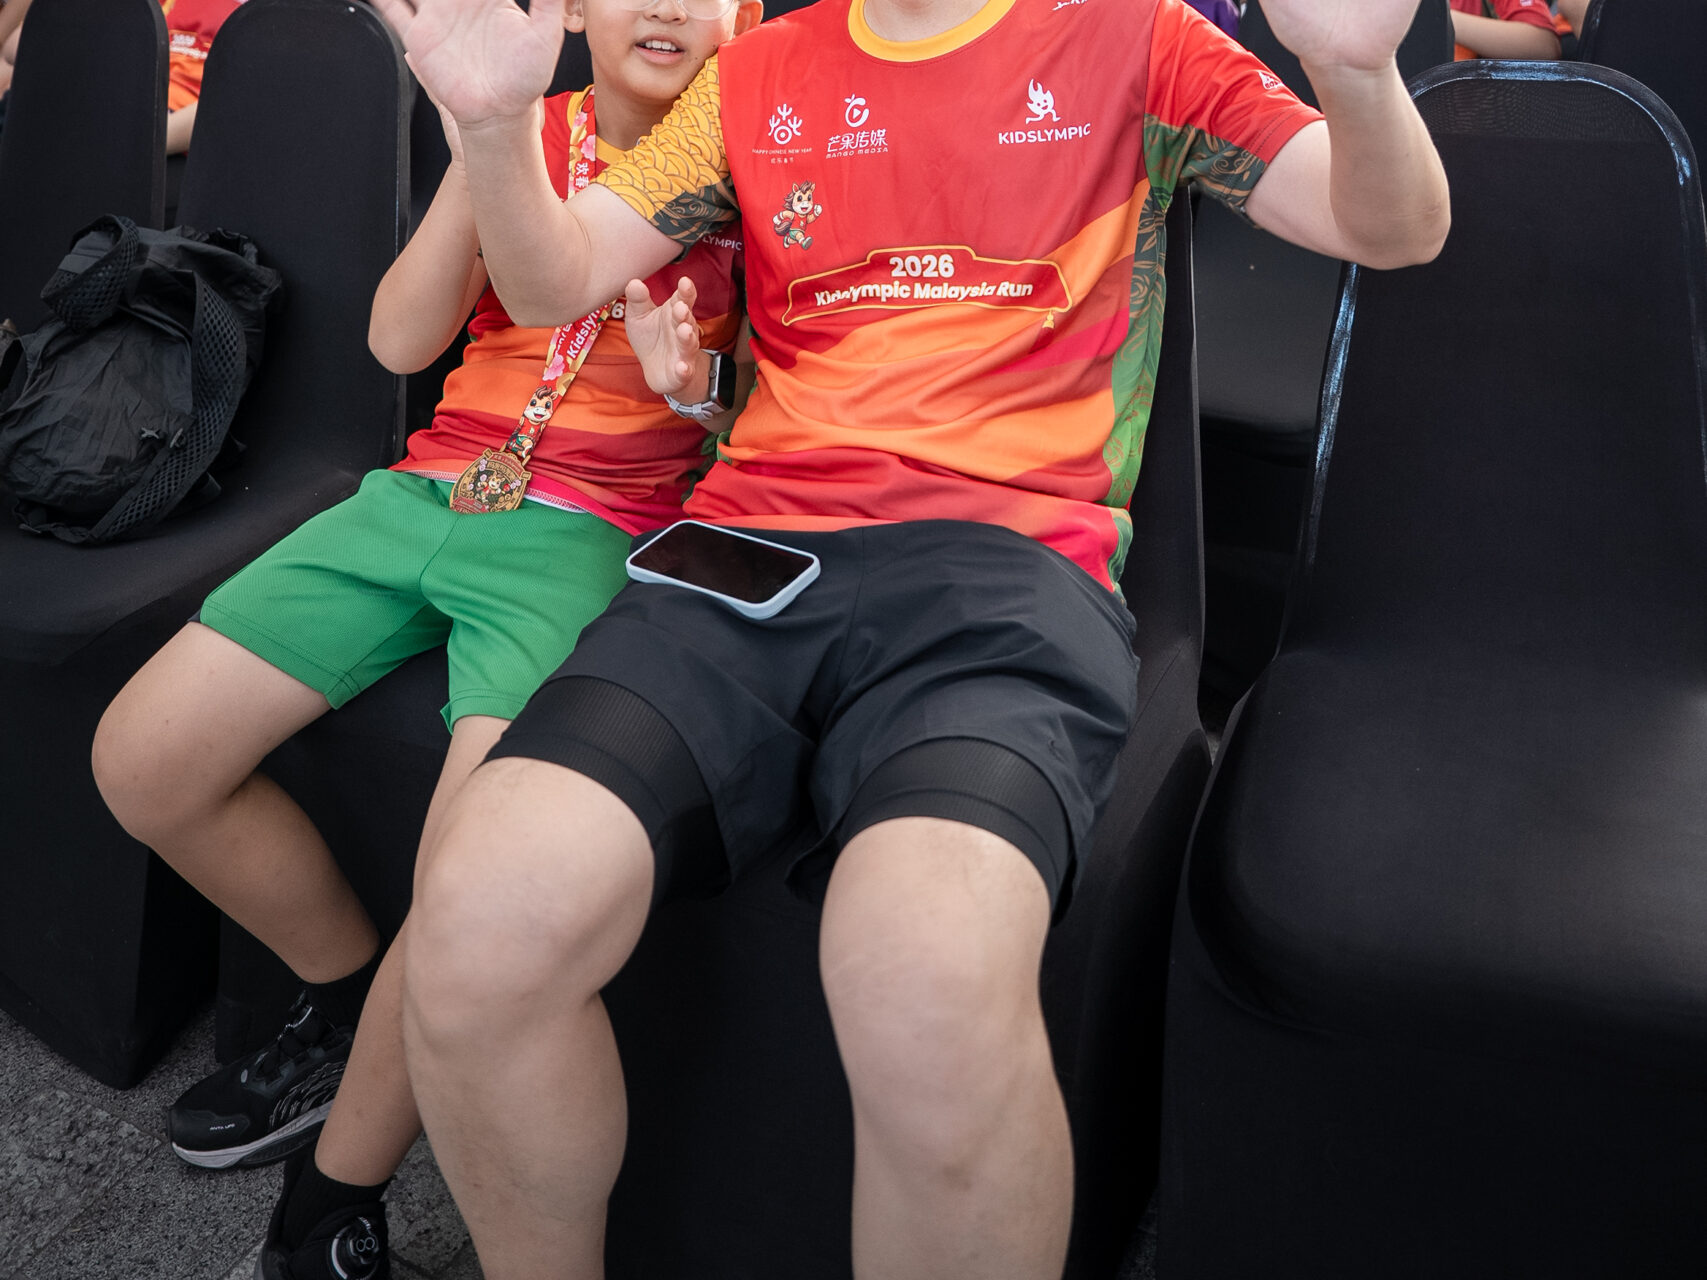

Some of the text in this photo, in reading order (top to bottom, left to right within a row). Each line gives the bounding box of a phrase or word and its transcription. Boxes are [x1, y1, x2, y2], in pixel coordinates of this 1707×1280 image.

[827, 128, 888, 152] 芒果传媒
[998, 122, 1091, 145] KIDSLYMPIC
[826, 147, 888, 159] MANGO MEDIA
[702, 235, 743, 251] LYMPIC
[889, 254, 955, 278] 2026
[913, 281, 997, 301] Malaysia
[996, 281, 1034, 297] Run
